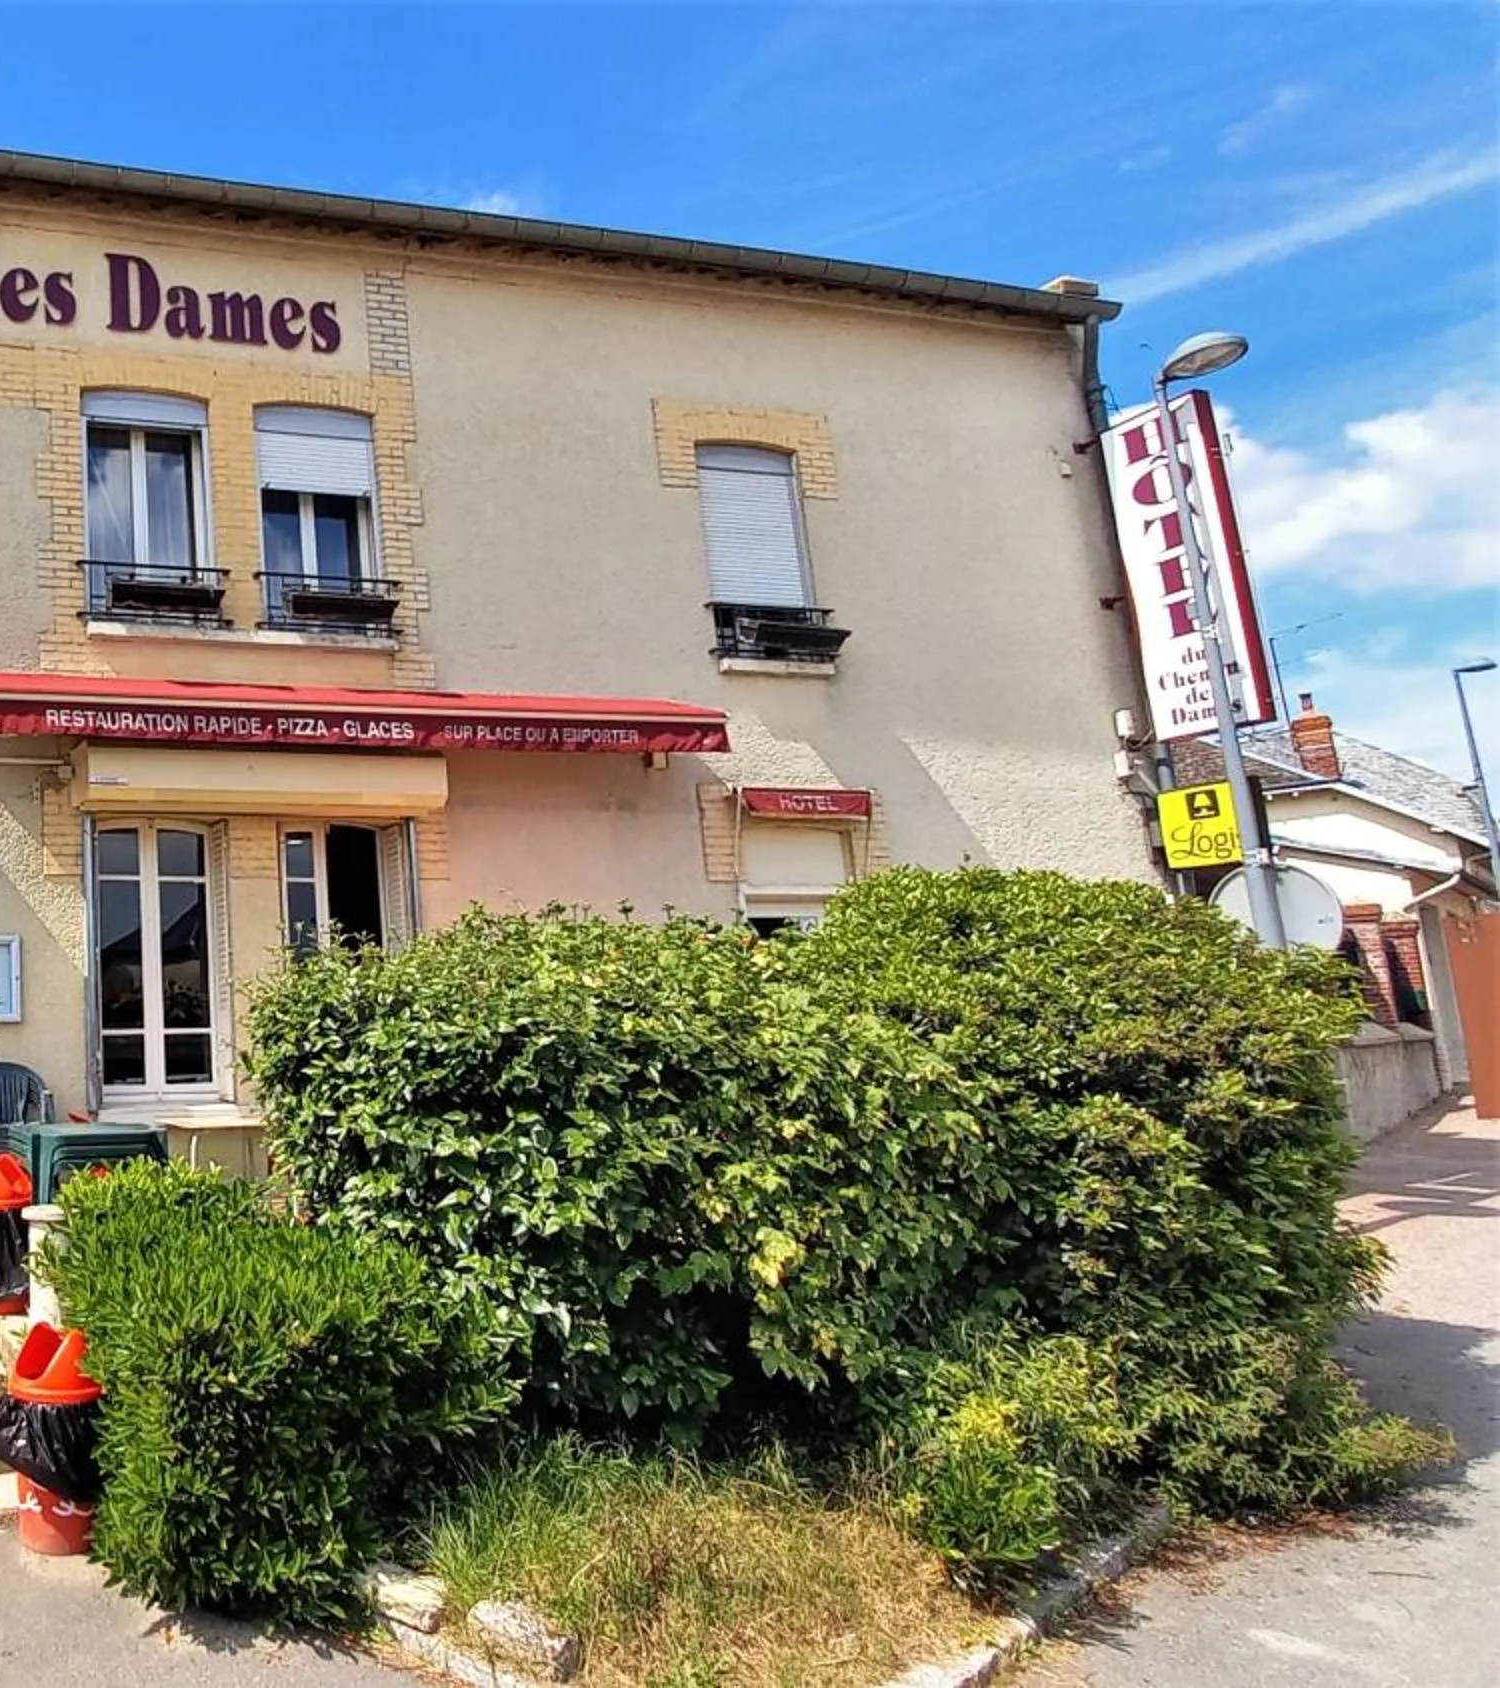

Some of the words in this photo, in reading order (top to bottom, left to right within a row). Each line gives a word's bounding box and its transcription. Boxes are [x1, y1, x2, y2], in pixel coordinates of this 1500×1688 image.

[104, 253, 342, 354] Dames
[45, 709, 190, 732] RESTAURATION
[195, 716, 262, 734] RAPIDE
[278, 718, 328, 736] PIZZA
[344, 720, 415, 740] GLACES
[444, 724, 473, 740] SUR
[477, 725, 523, 742] PLACE
[526, 727, 547, 743] OU
[779, 795, 840, 812] HOTEL
[1171, 821, 1242, 860] Logi
